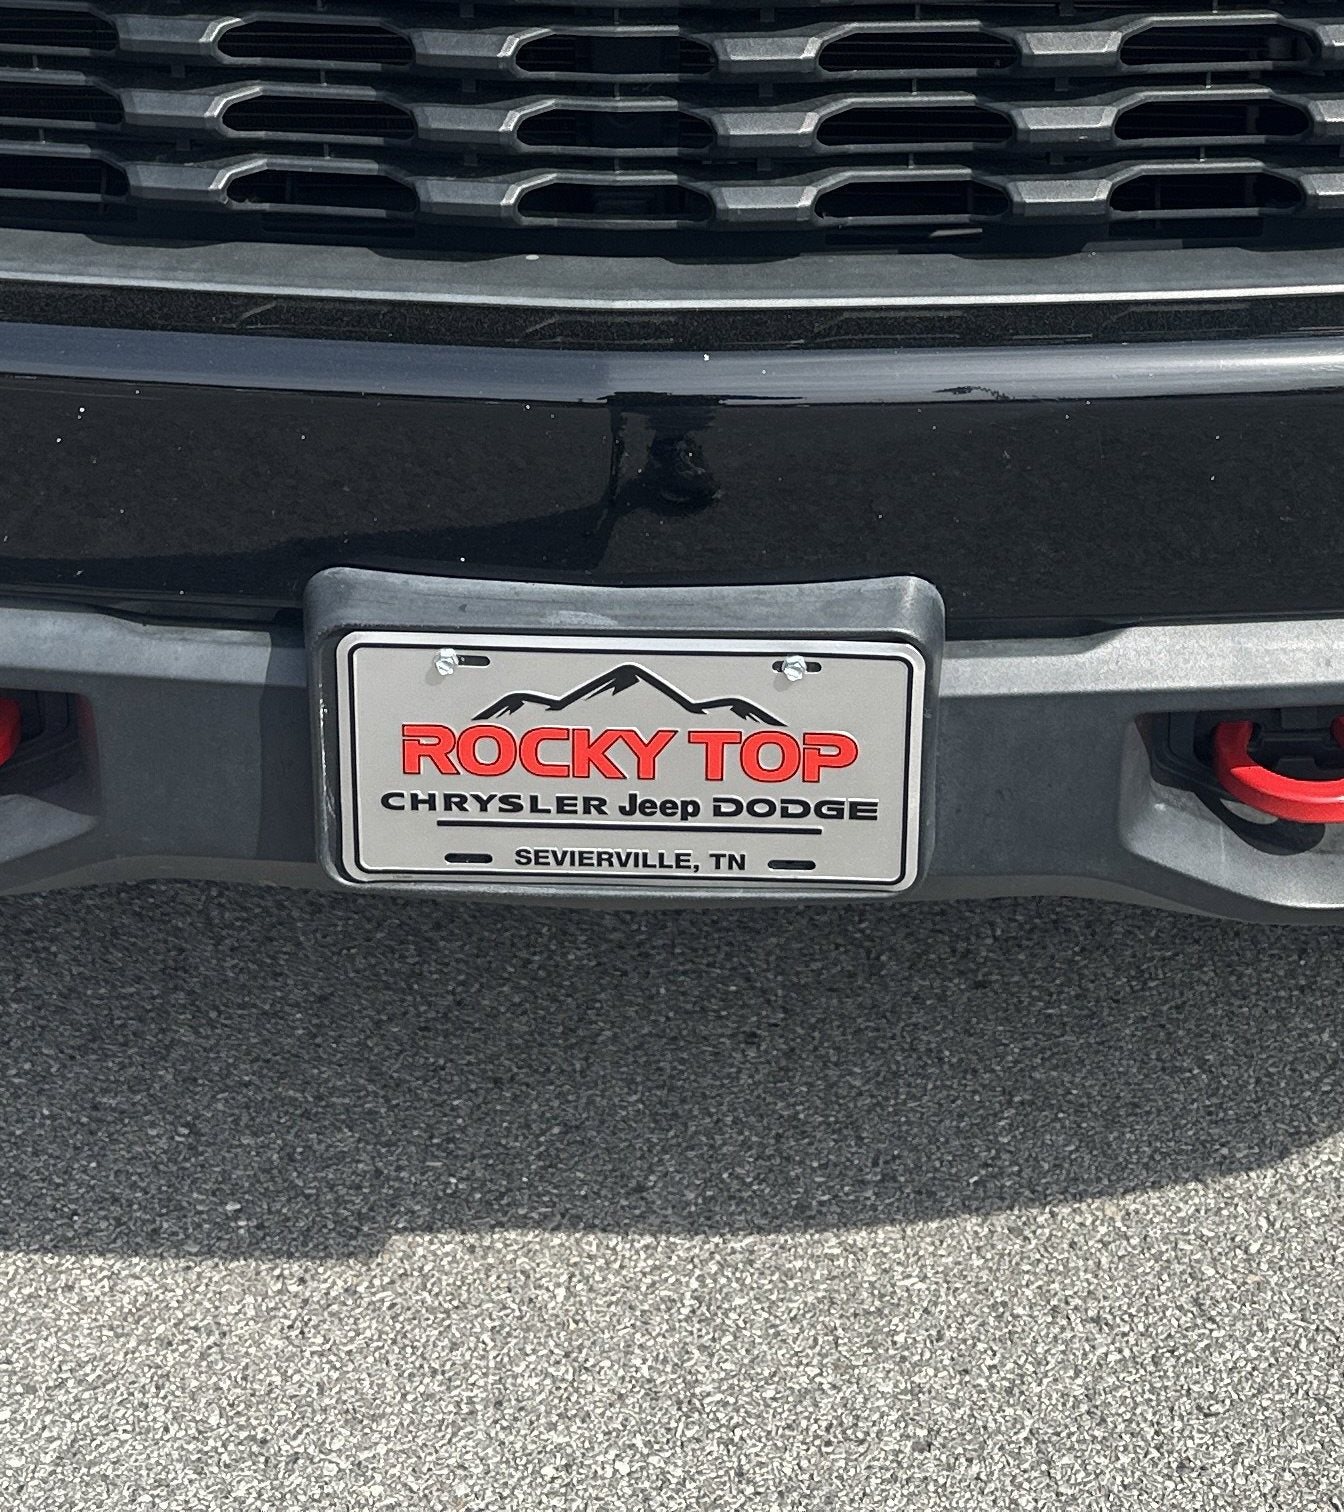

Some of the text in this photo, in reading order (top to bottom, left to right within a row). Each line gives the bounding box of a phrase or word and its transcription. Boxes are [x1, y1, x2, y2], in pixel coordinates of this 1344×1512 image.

[400, 722, 859, 784] ROCKY TOP
[380, 791, 880, 821] CHRYSLER Jeep DODGE
[514, 846, 747, 871] SEVIERVILLE, TN
